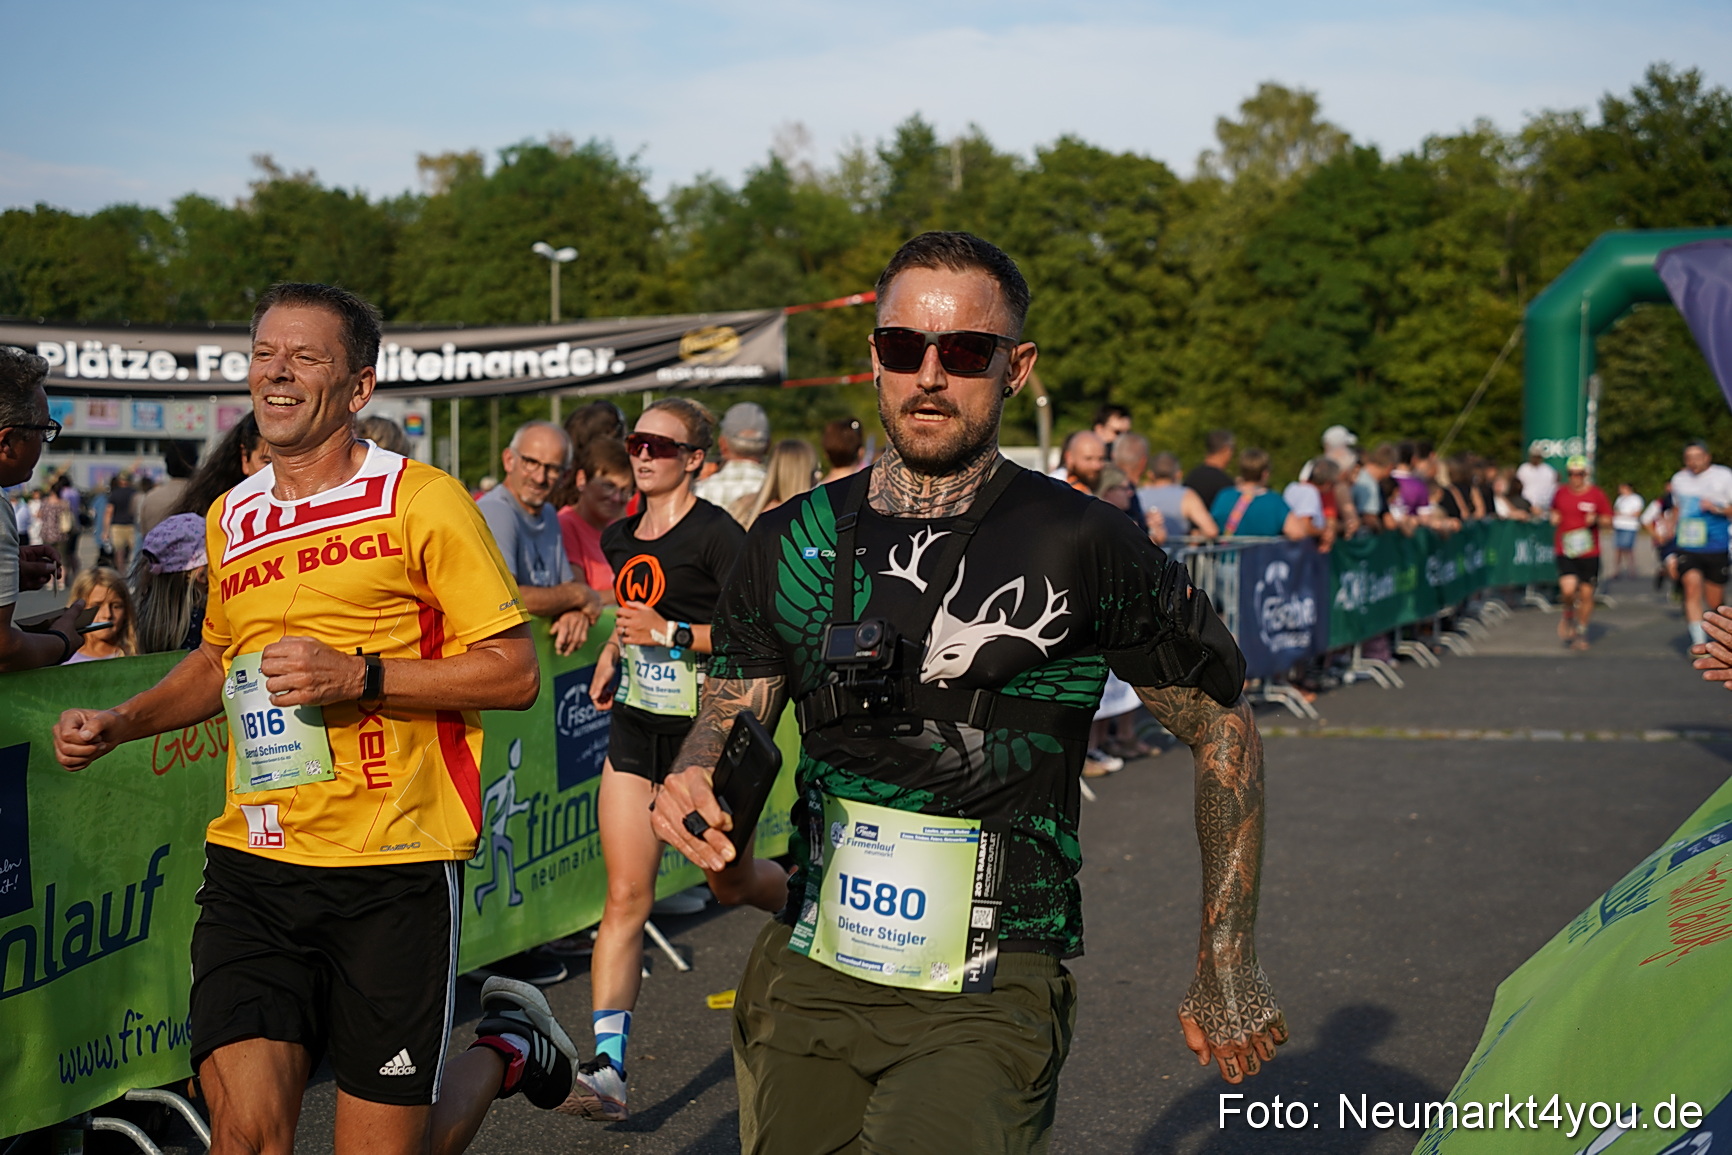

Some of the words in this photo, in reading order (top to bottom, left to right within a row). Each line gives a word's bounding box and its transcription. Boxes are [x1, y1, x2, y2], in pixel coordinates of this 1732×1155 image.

[36, 341, 189, 381] Plätze.
[220, 555, 286, 604] MAX
[297, 532, 403, 574] BÖGL
[635, 660, 676, 682] 2734
[240, 708, 286, 740] 1816
[258, 740, 302, 757] Schimek
[846, 837, 895, 852] Firmenlauf
[977, 830, 989, 872] RABATT
[987, 832, 997, 863] OUTLET
[839, 872, 926, 921] 1580
[838, 915, 874, 937] Dieter
[878, 926, 927, 946] Stigler
[968, 932, 985, 983] HILTL
[379, 1065, 417, 1076] adidas
